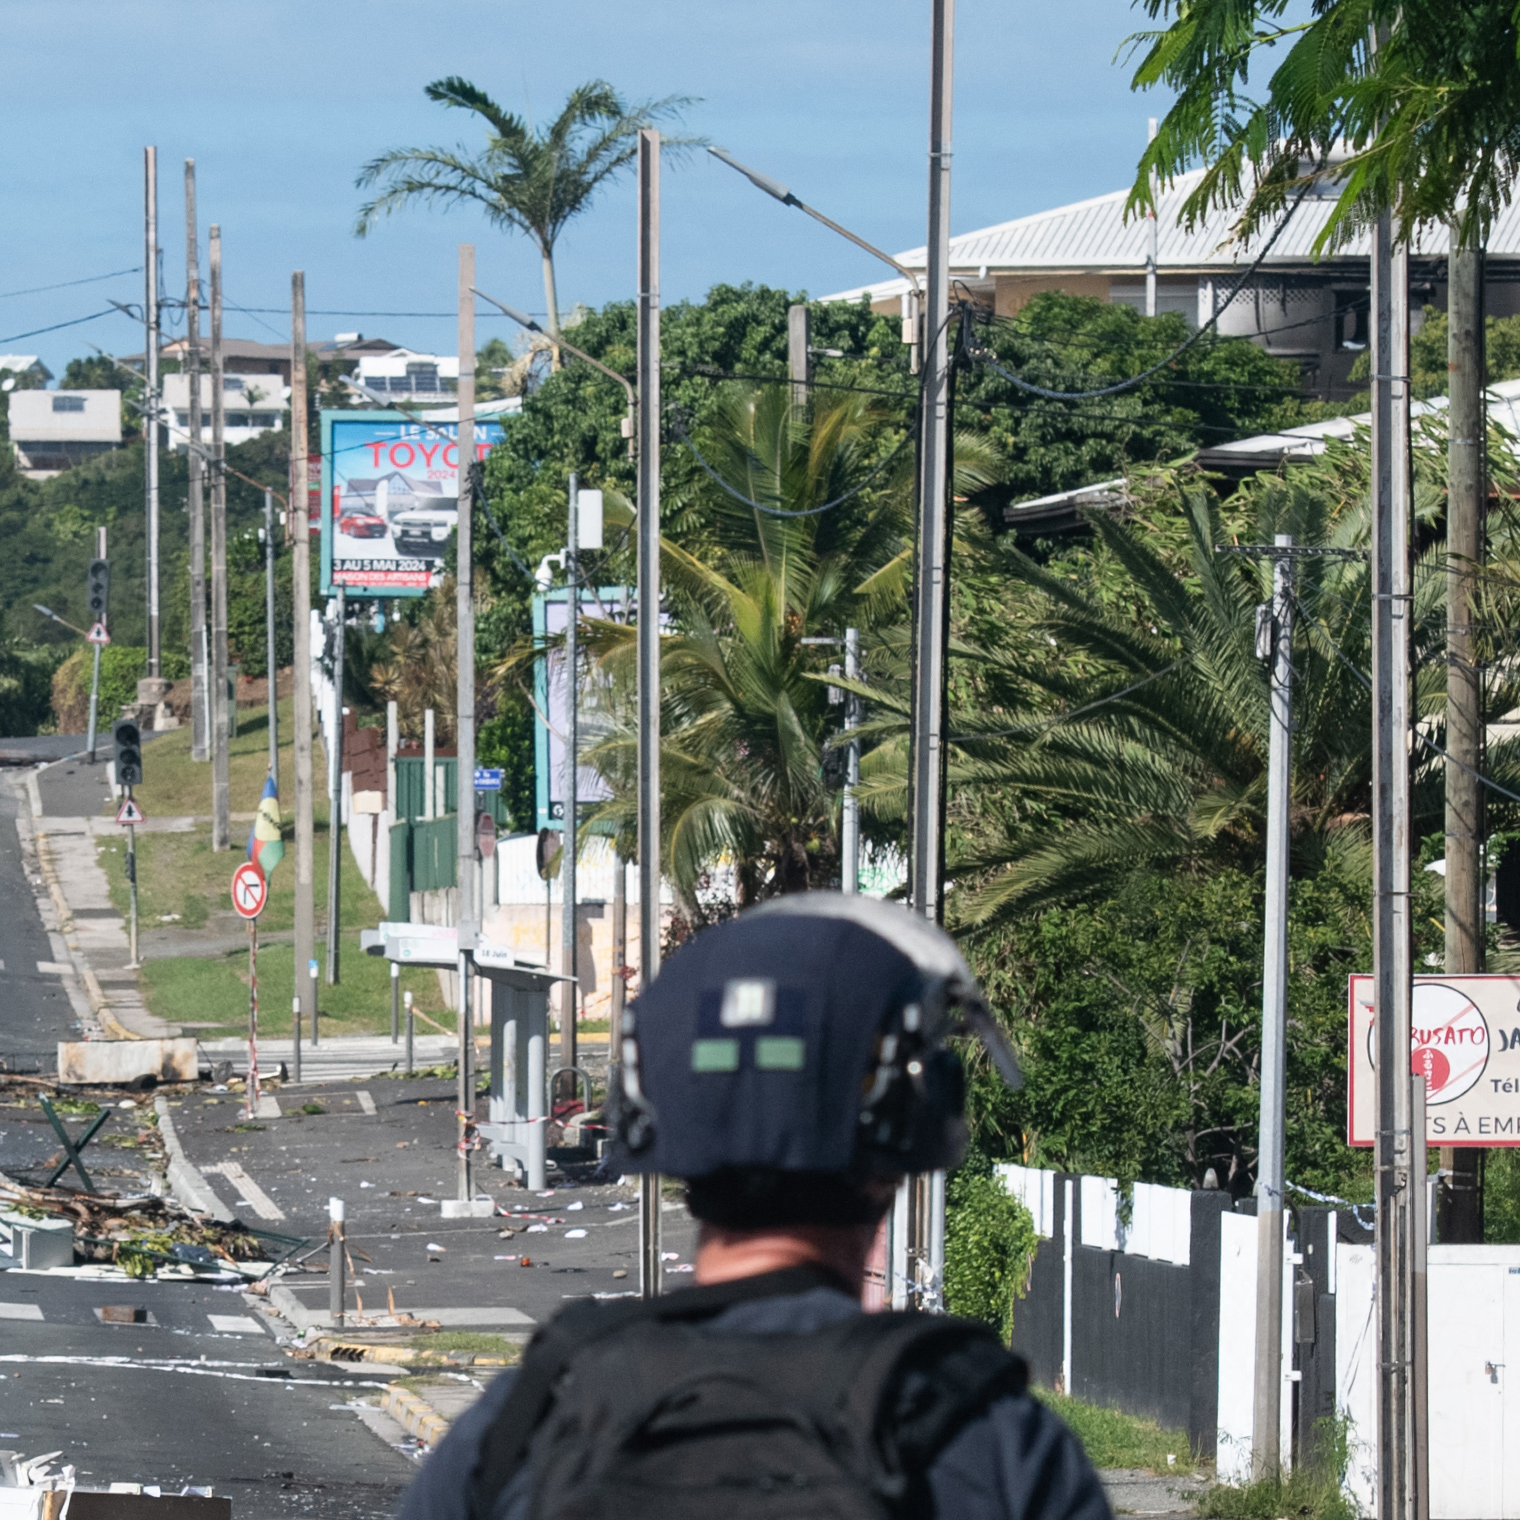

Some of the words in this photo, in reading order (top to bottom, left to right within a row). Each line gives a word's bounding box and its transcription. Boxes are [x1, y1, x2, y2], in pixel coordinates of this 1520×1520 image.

[400, 425, 420, 440] LE
[425, 425, 487, 440] SALN
[365, 441, 493, 469] TOYOT
[427, 470, 456, 480] 2024
[333, 560, 342, 571] 3
[343, 560, 361, 571] AU
[363, 560, 371, 571] 5
[373, 560, 396, 571] MAI
[398, 560, 426, 571] 2024
[1412, 1025, 1485, 1046] RUSATO
[1490, 1078, 1520, 1093] Tél
[1453, 1111, 1471, 1135] À
